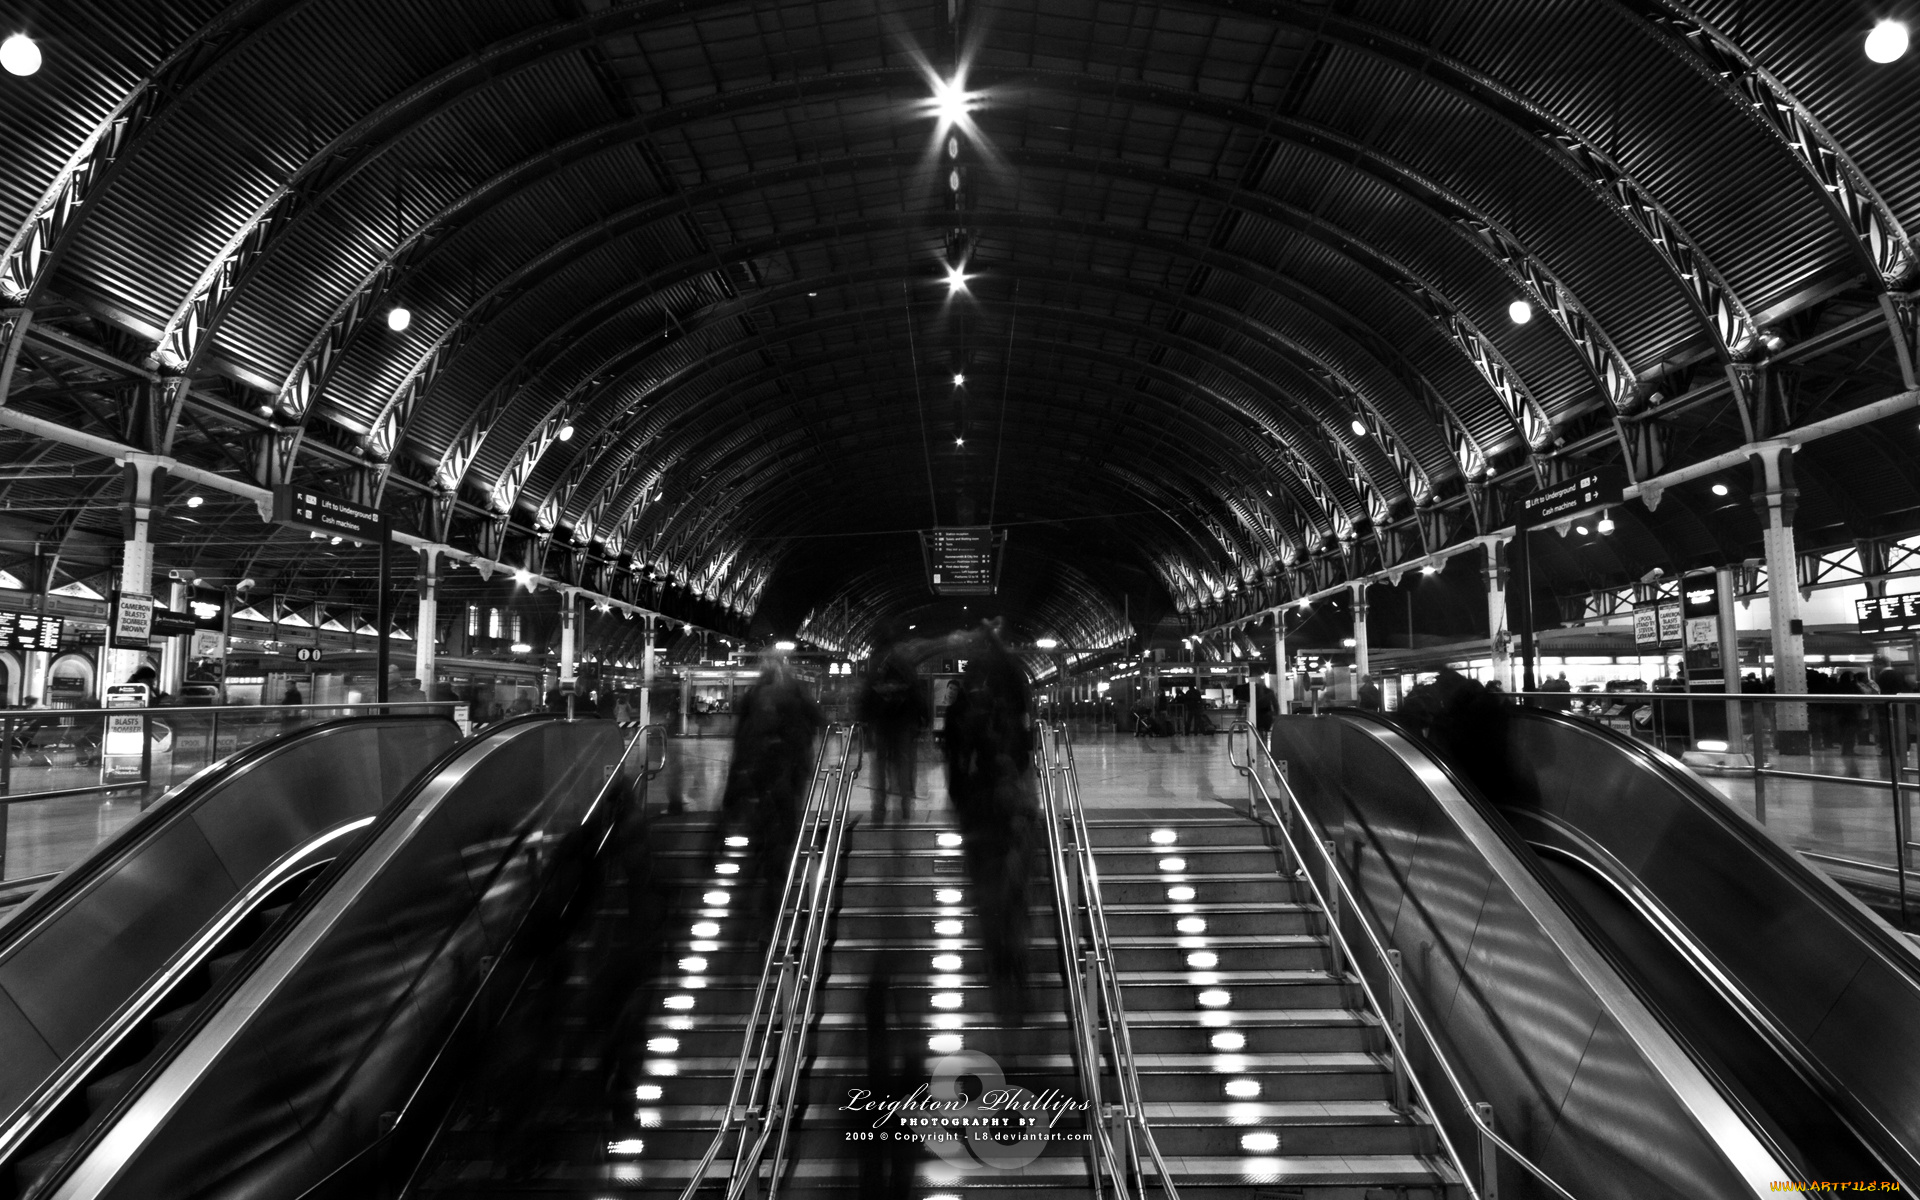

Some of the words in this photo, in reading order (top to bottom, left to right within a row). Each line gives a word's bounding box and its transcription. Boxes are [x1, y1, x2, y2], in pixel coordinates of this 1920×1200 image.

[1531, 498, 1540, 506] Lift
[1545, 483, 1576, 501] Underground
[321, 500, 332, 508] Lift
[339, 505, 372, 520] Underground
[1542, 507, 1553, 516] Cash
[1554, 500, 1577, 512] machines
[321, 514, 335, 524] Cash
[336, 519, 360, 531] machines
[121, 602, 150, 612] CAMERON
[125, 610, 146, 618] BLASTS
